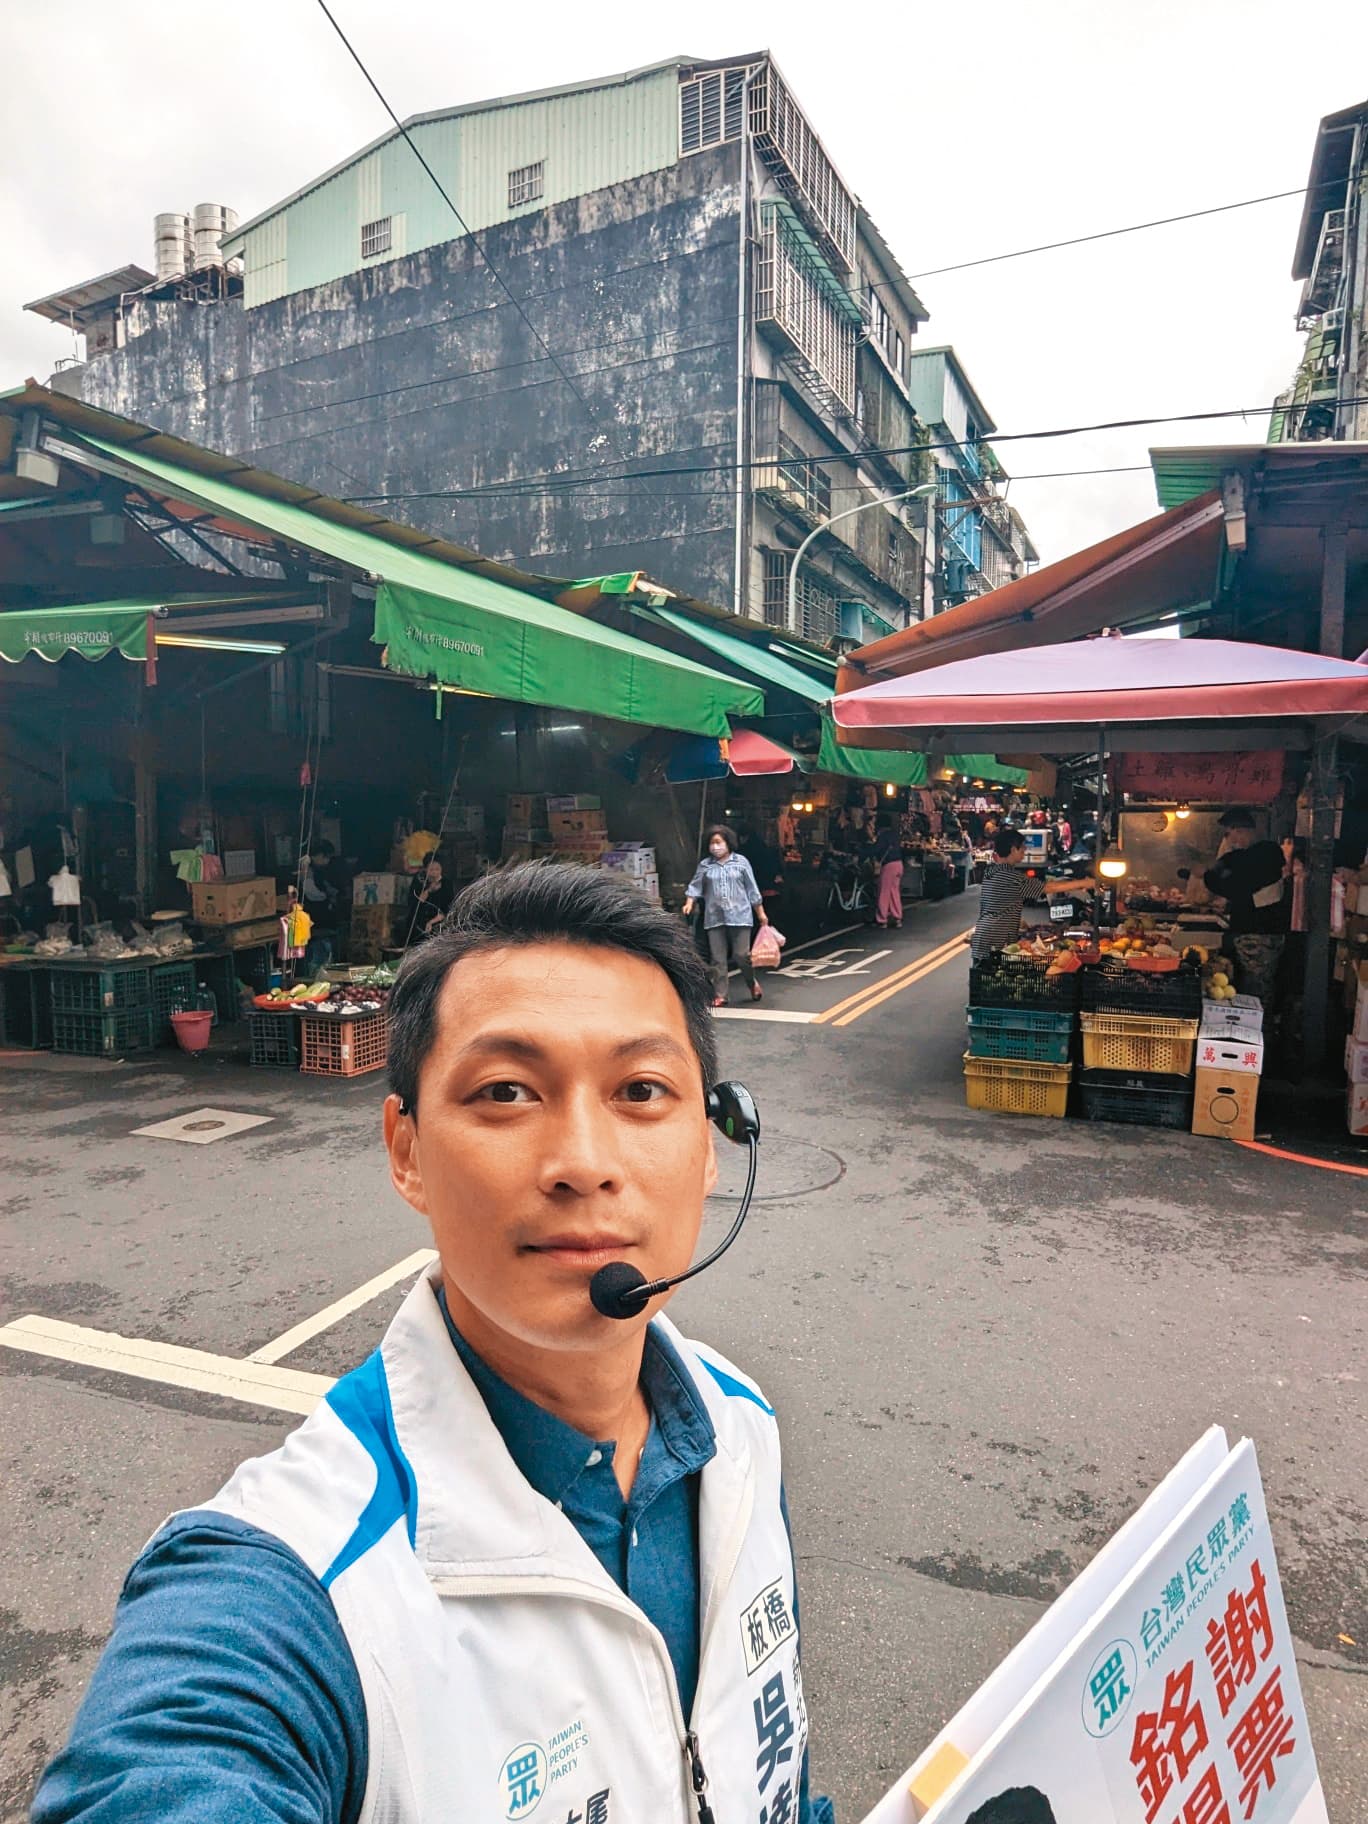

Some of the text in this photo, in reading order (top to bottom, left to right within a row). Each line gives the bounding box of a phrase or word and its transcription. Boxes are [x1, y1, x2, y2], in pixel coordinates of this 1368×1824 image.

[1139, 1492, 1251, 1651] 台灣民眾黨
[1144, 1524, 1255, 1669] TAIWAN PEOPLE'S PARTY
[747, 1588, 791, 1662] 板橋
[548, 1720, 582, 1751] TAIWAN
[549, 1734, 590, 1767] PEOPLE'S
[550, 1757, 579, 1783] PARTY
